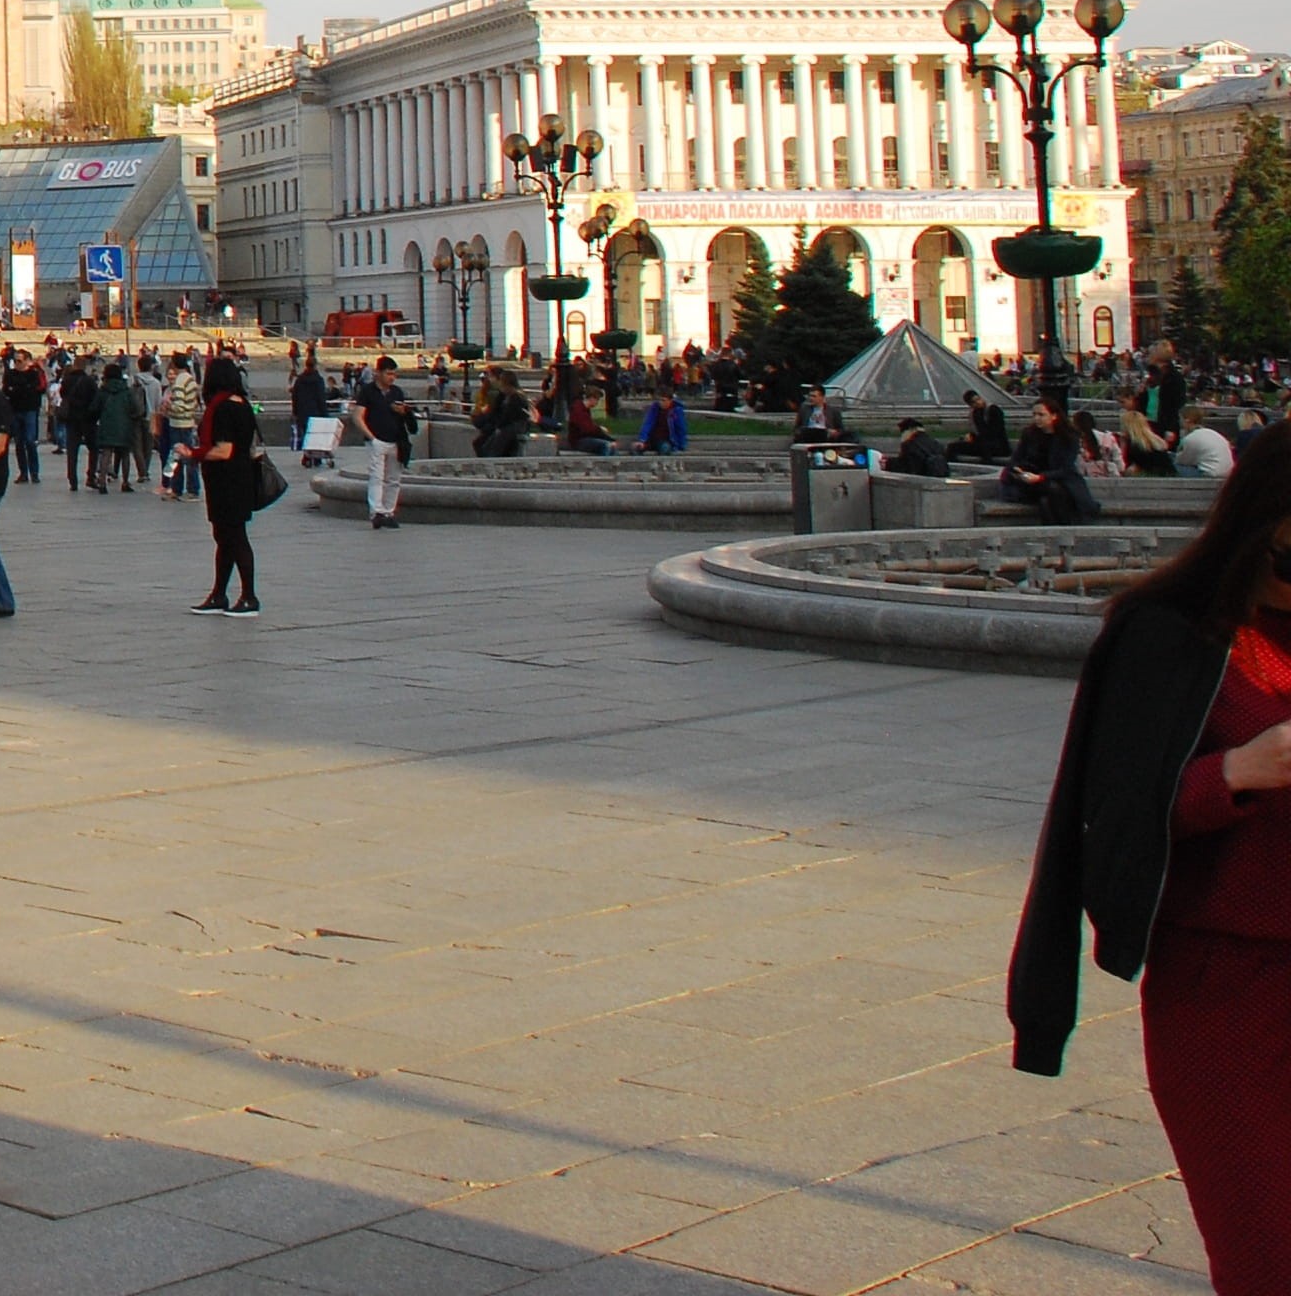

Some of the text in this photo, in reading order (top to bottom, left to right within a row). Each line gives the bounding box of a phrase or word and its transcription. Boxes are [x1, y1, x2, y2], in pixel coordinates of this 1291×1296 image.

[58, 159, 142, 181] GLOBUS
[637, 203, 725, 221] МІЖНАРОДНА
[729, 203, 808, 219] ПАСХАЛЬНА
[815, 203, 883, 219] АСАМБЛЕЯ
